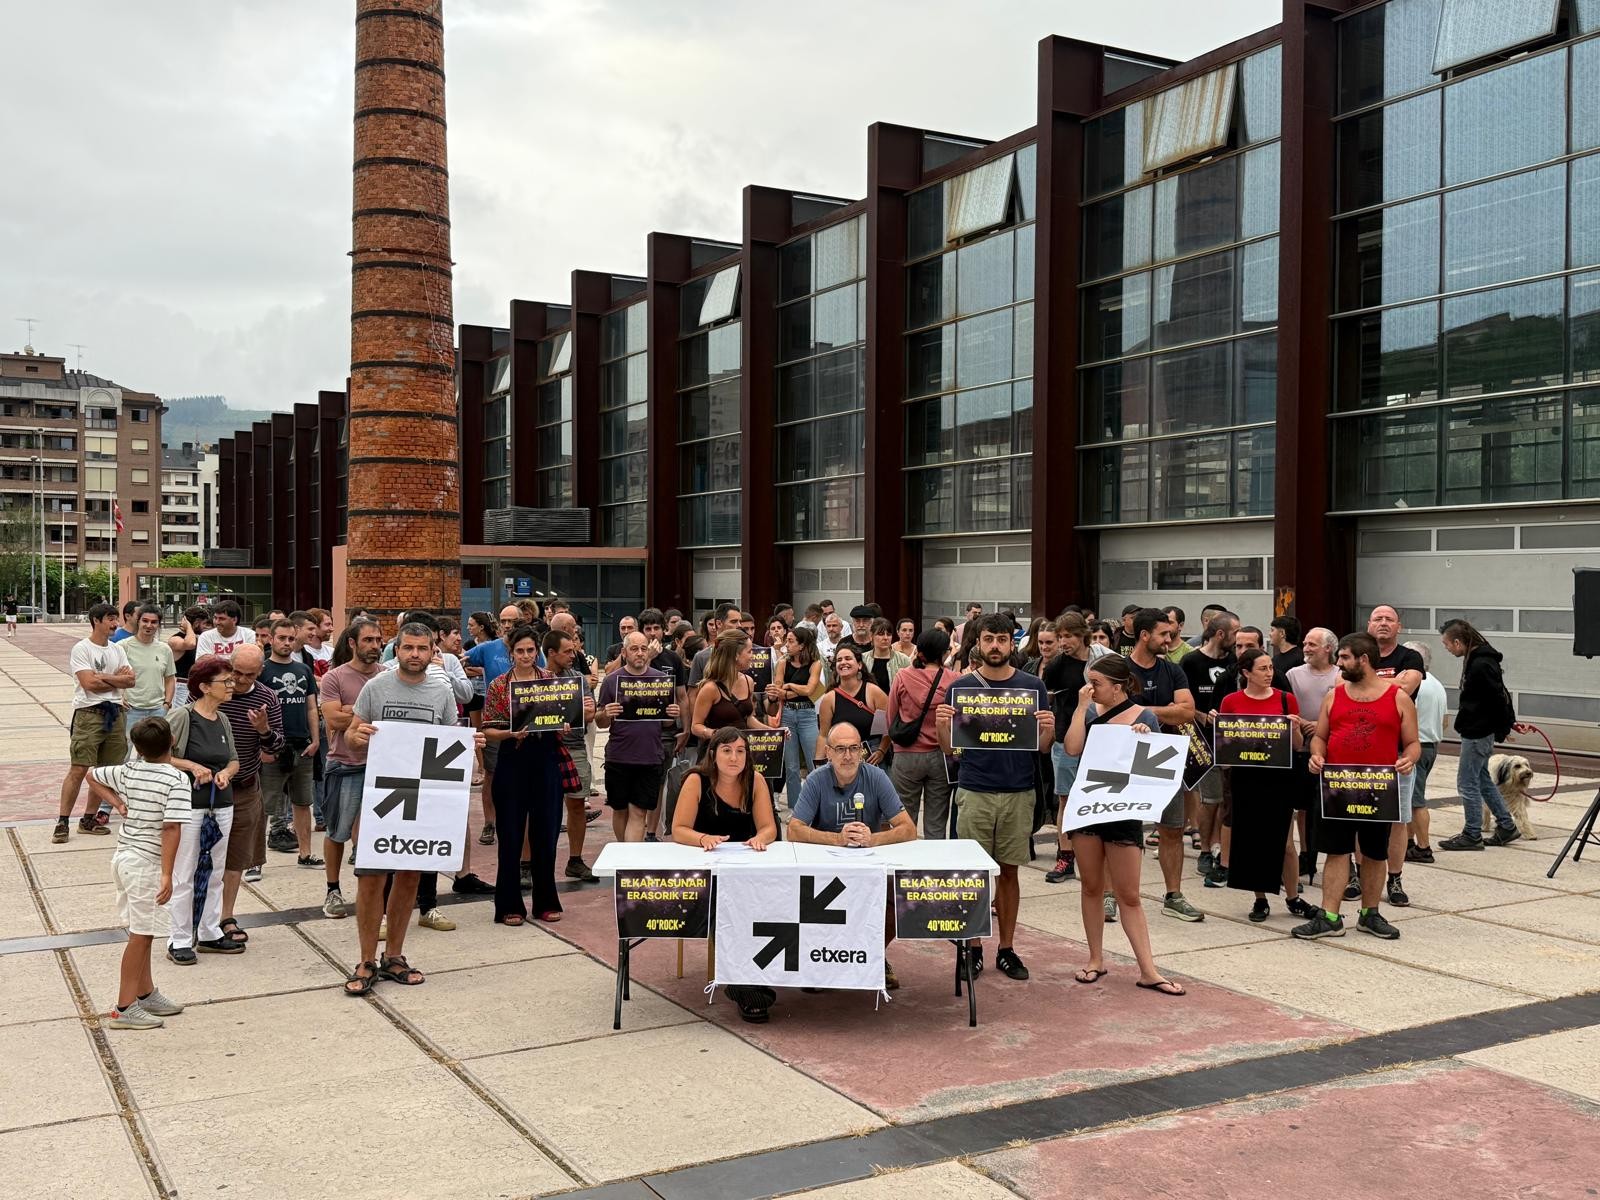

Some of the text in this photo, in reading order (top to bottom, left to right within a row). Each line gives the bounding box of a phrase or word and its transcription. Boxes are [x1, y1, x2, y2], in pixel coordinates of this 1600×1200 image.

[514, 683, 579, 695] ELKARTASUNARI
[520, 694, 559, 704] ERASORIK
[957, 695, 1034, 705] ELKARTASUNARI
[962, 706, 1026, 716] ERASORIK EZ!
[1218, 721, 1287, 730] ELKARTASUNARI
[1223, 730, 1280, 739] ERASORIK EZ!
[1324, 771, 1394, 780] ELKARTASUNARI
[1329, 781, 1388, 790] ERASORIK EZ!
[1077, 802, 1152, 816] etxera
[374, 835, 452, 856] etxera
[620, 878, 706, 888] ELKARTASUNARI
[900, 878, 985, 888] ELKARTASUNARI
[627, 891, 698, 900] ERASORIK EZ!
[906, 892, 977, 900] ERASORIK EZ!
[810, 947, 867, 964] etxera
